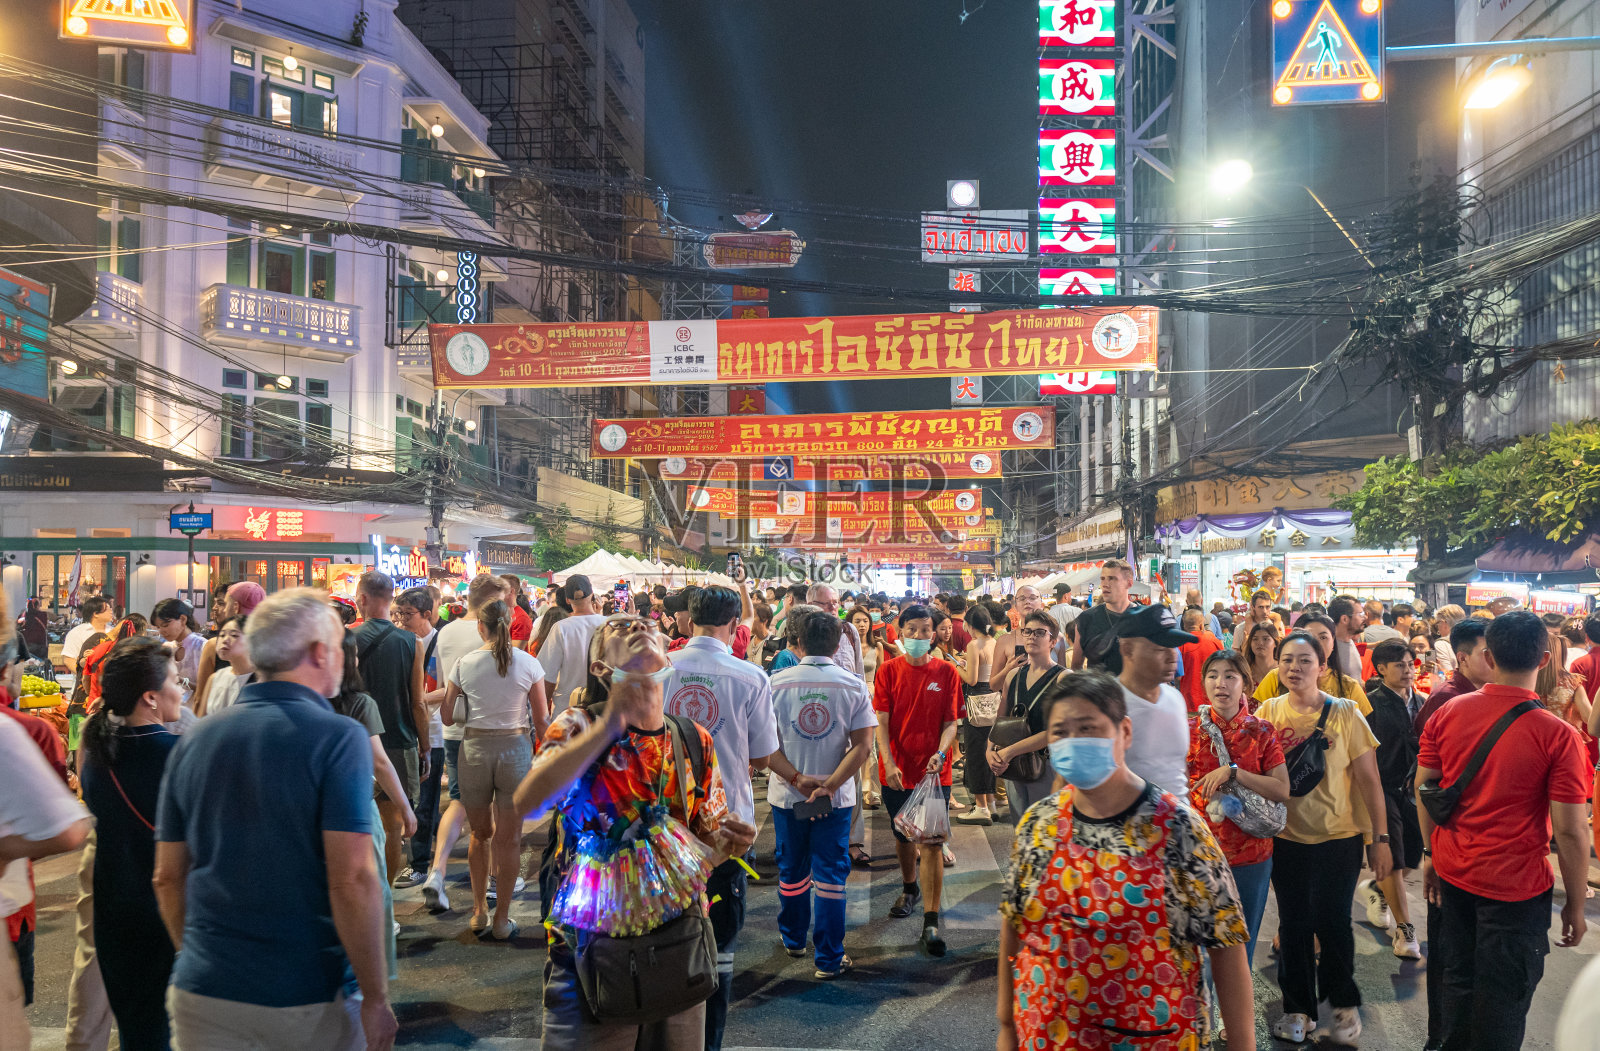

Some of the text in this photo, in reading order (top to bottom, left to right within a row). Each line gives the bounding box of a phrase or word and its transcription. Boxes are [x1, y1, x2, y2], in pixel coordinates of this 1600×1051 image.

[673, 344, 695, 352] ICBC
[856, 441, 885, 450] 800
[926, 439, 944, 448] 24
